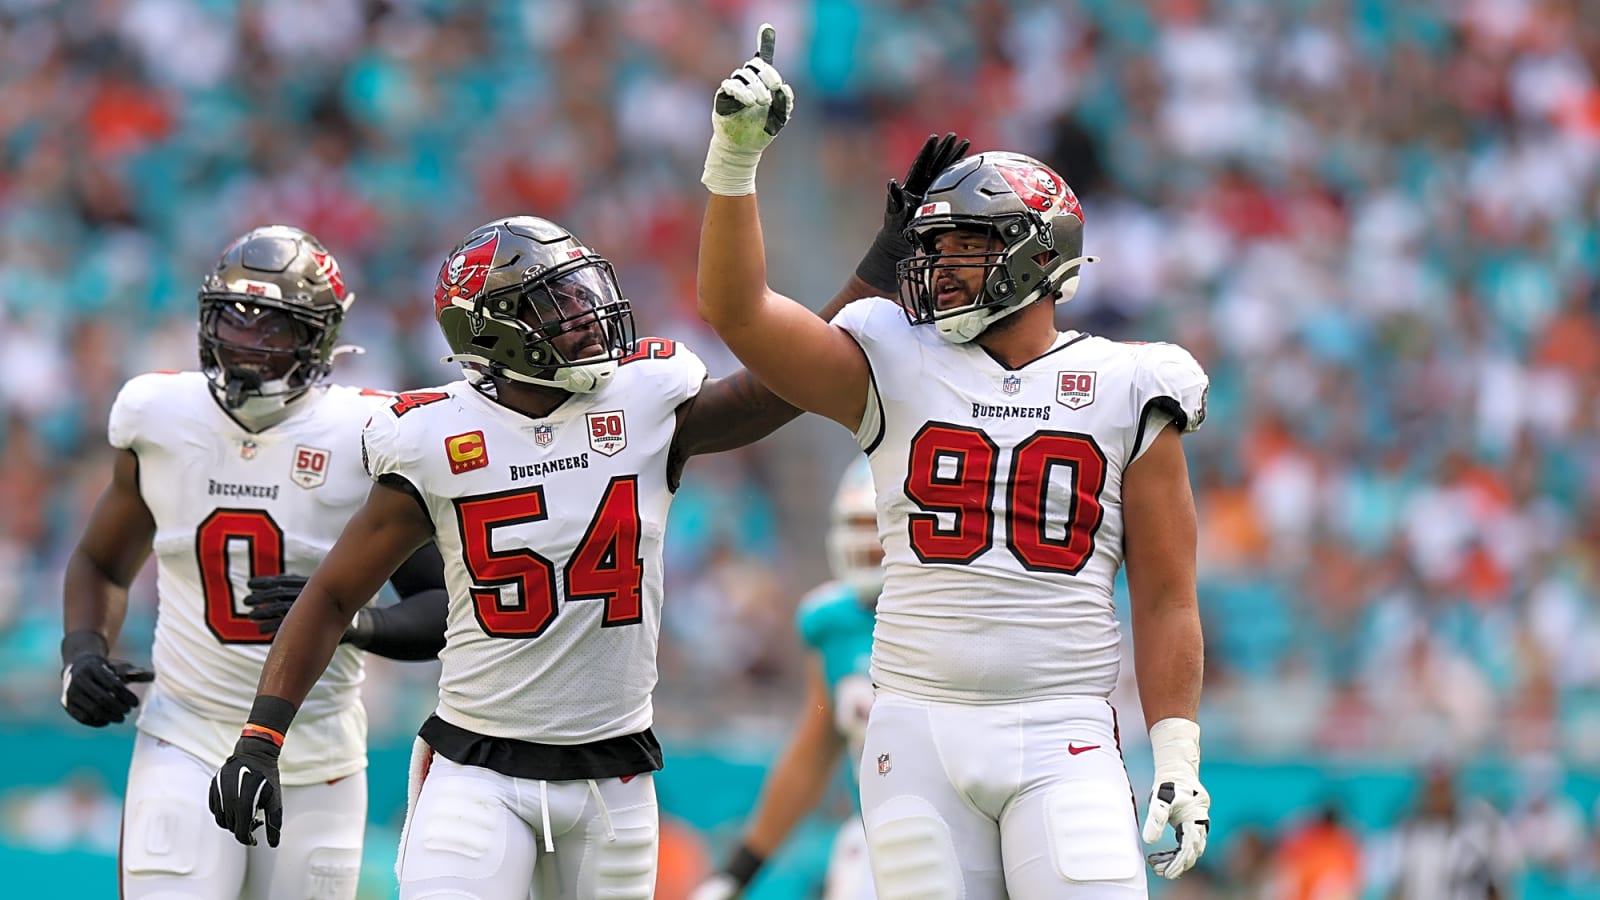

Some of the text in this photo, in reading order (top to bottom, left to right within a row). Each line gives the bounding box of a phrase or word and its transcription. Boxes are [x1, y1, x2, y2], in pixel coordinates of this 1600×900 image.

[1061, 374, 1092, 392] 50
[972, 402, 1051, 420] BUCCANEERS
[591, 414, 622, 438] 50
[296, 449, 326, 472] 50
[448, 433, 484, 463] C
[509, 452, 589, 481] BUCCANEERS
[207, 478, 280, 501] BUCCANEERS
[903, 420, 1108, 576] 90
[452, 474, 645, 640] 54
[195, 507, 286, 645] 0
